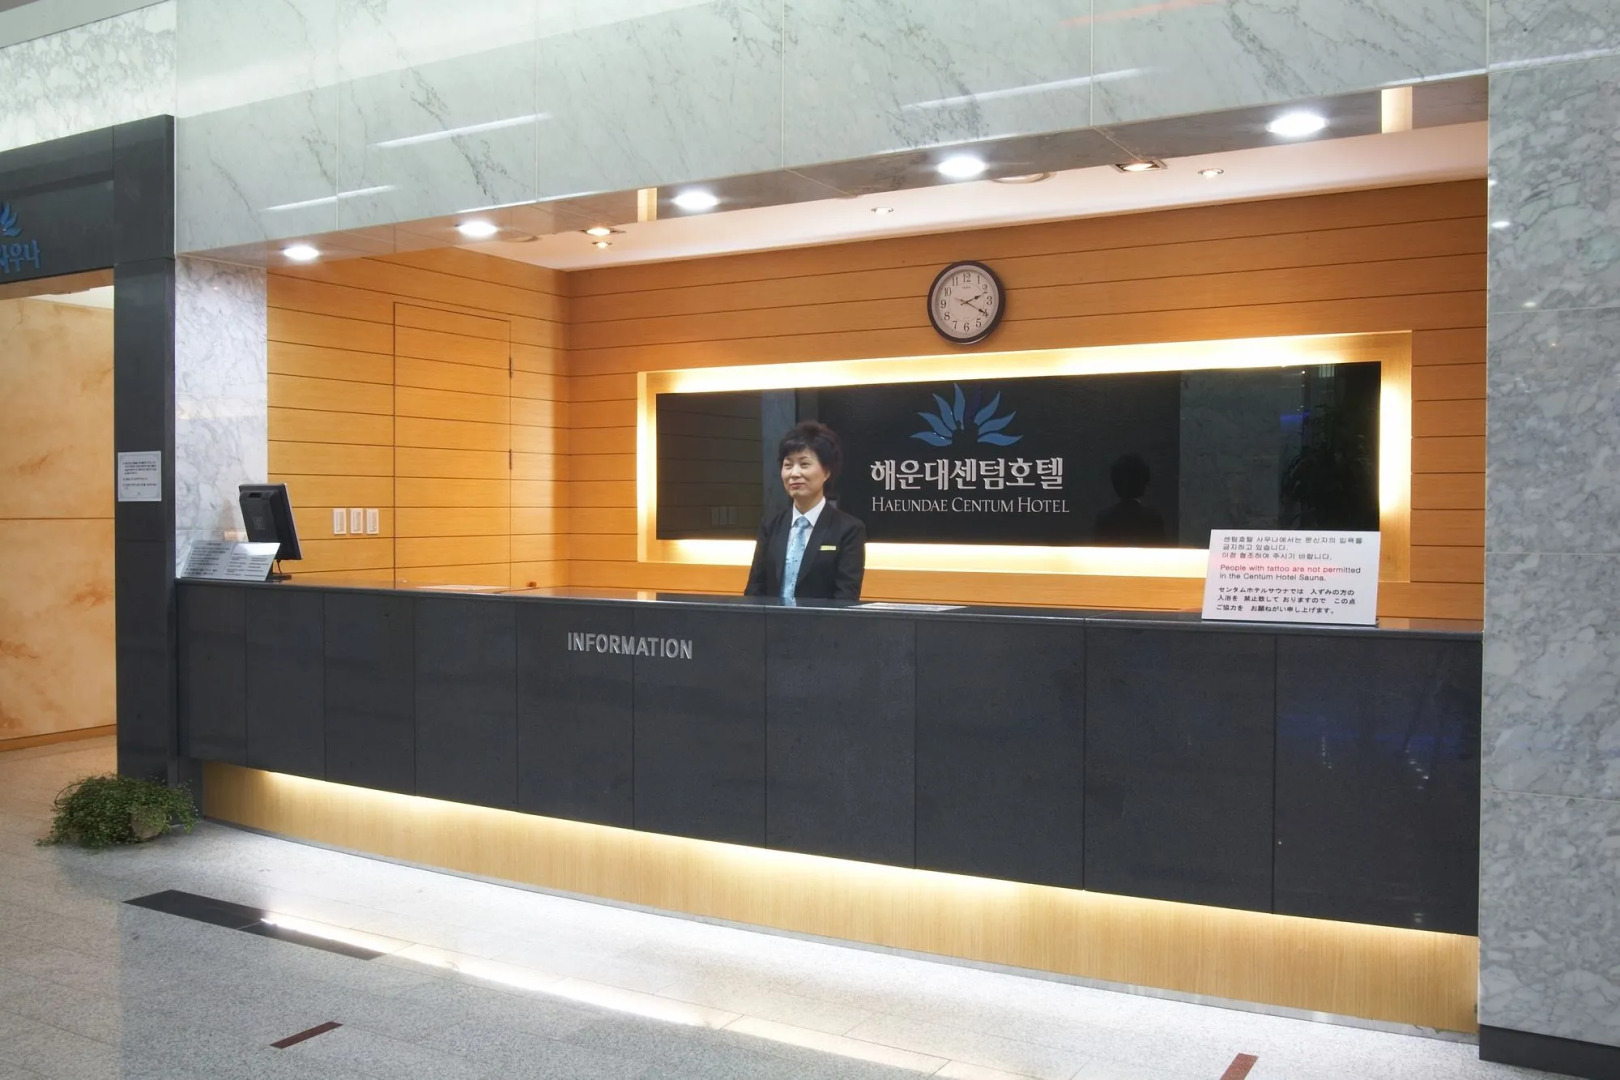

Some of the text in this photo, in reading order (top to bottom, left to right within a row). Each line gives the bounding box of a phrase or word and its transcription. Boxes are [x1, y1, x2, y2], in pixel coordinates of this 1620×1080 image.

[952, 277, 959, 287] 11
[962, 272, 971, 283] 12
[944, 287, 952, 297] 10
[982, 284, 988, 294] 2
[940, 300, 947, 309] 9
[986, 296, 993, 306] 3
[944, 312, 951, 321] 8
[952, 320, 958, 330] 7
[963, 322, 970, 332] 6
[975, 318, 982, 328] 5
[870, 457, 1064, 491] 해운대센텀호텔
[872, 497, 1070, 513] HAEUNDAE CENTUM HOTEL
[1256, 536, 1302, 544] 사우나에서는
[1220, 564, 1246, 572] People
[1323, 566, 1361, 575] permitted
[1299, 574, 1327, 582] Sauna.
[567, 632, 693, 660] INFORMATION
